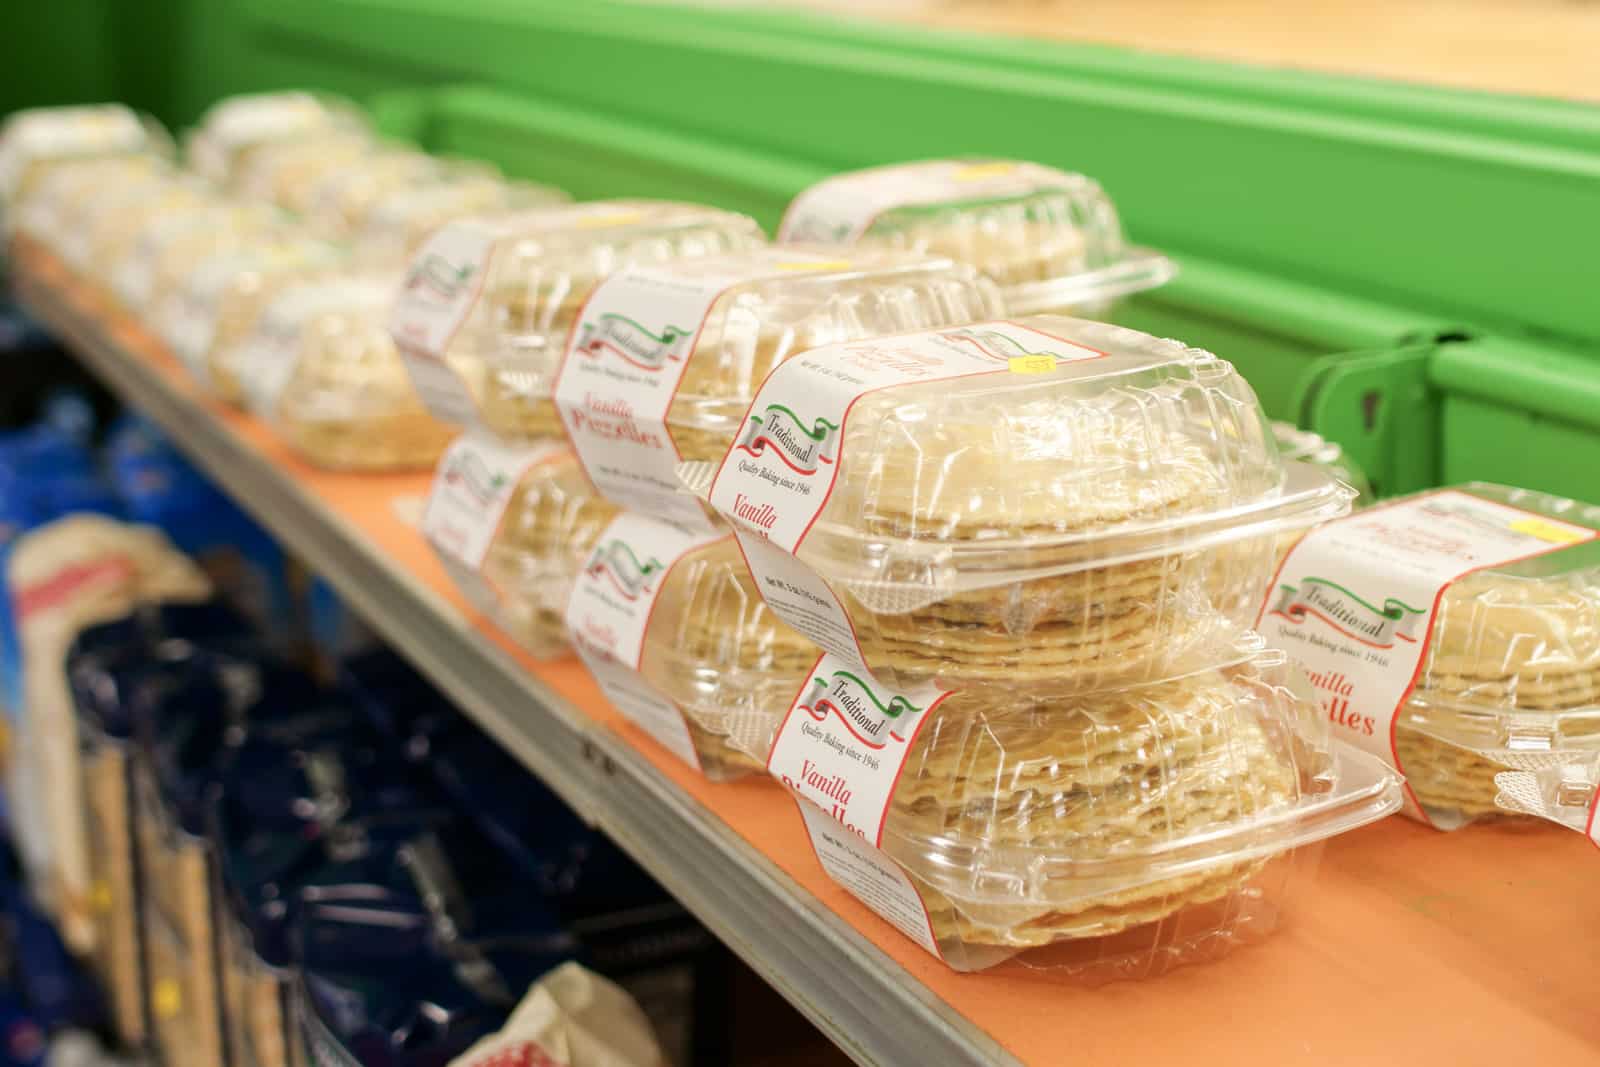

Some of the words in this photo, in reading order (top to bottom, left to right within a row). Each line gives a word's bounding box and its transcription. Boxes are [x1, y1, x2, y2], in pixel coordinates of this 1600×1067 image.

[767, 413, 813, 463] Traditional
[738, 459, 759, 474] Quality
[758, 467, 780, 487] Baking
[779, 478, 796, 491] since
[733, 493, 777, 529] Vanilla
[1306, 584, 1385, 638] Traditional
[1305, 669, 1353, 697] nilla
[832, 680, 886, 736] Traditional
[801, 720, 824, 743] Quality
[824, 732, 846, 756] Baking
[846, 746, 862, 762] since
[863, 752, 881, 771] 1946
[800, 759, 852, 805] Vanilla
